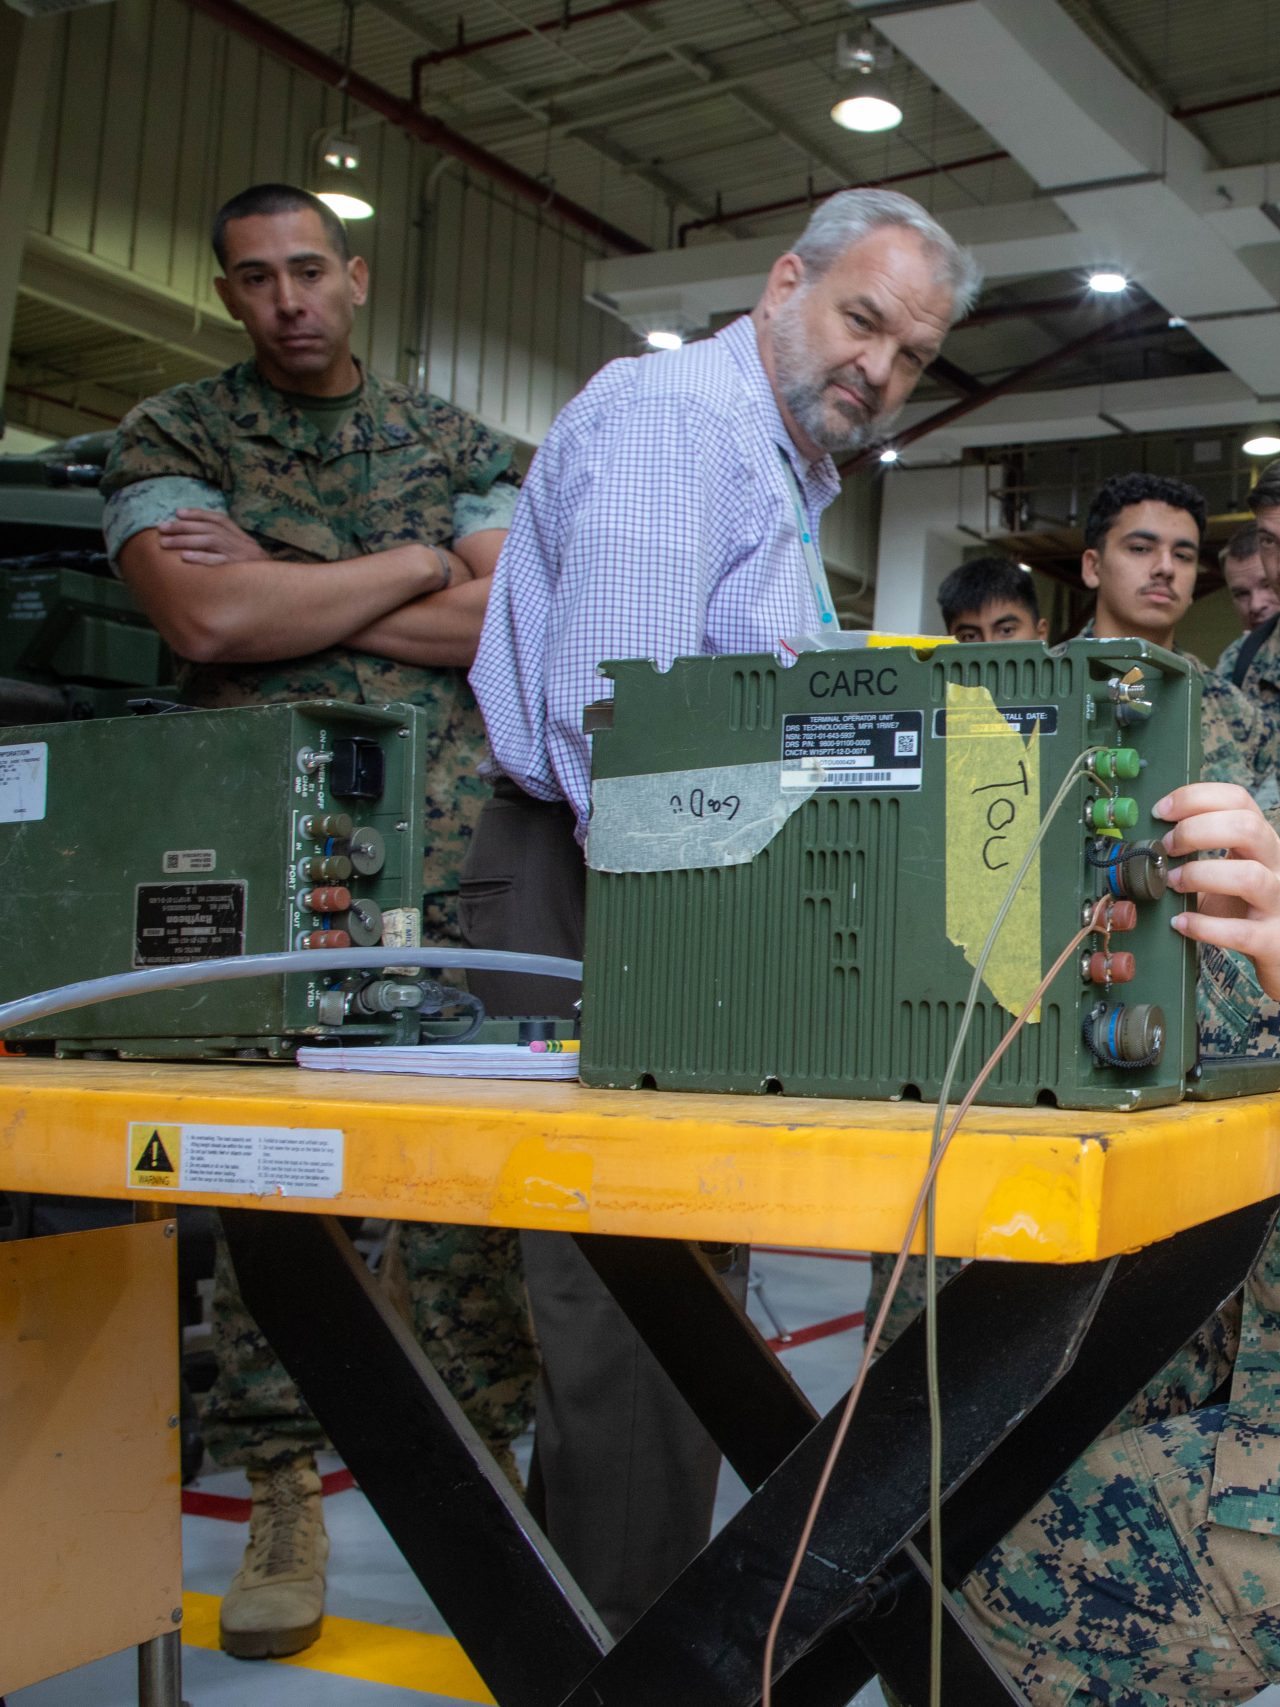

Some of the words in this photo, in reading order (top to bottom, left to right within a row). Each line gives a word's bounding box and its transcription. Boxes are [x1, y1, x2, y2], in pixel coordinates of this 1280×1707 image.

[809, 668, 898, 698] CARC
[810, 715, 840, 723] TERMINAL
[842, 714, 877, 722] OPERATOR
[1026, 711, 1047, 720] DATE:
[785, 724, 800, 732] DRS
[785, 740, 800, 748] DRS
[971, 760, 1029, 871] TOU
[295, 842, 302, 850] IN
[314, 845, 321, 854] J1
[138, 1175, 170, 1186] WARNING
